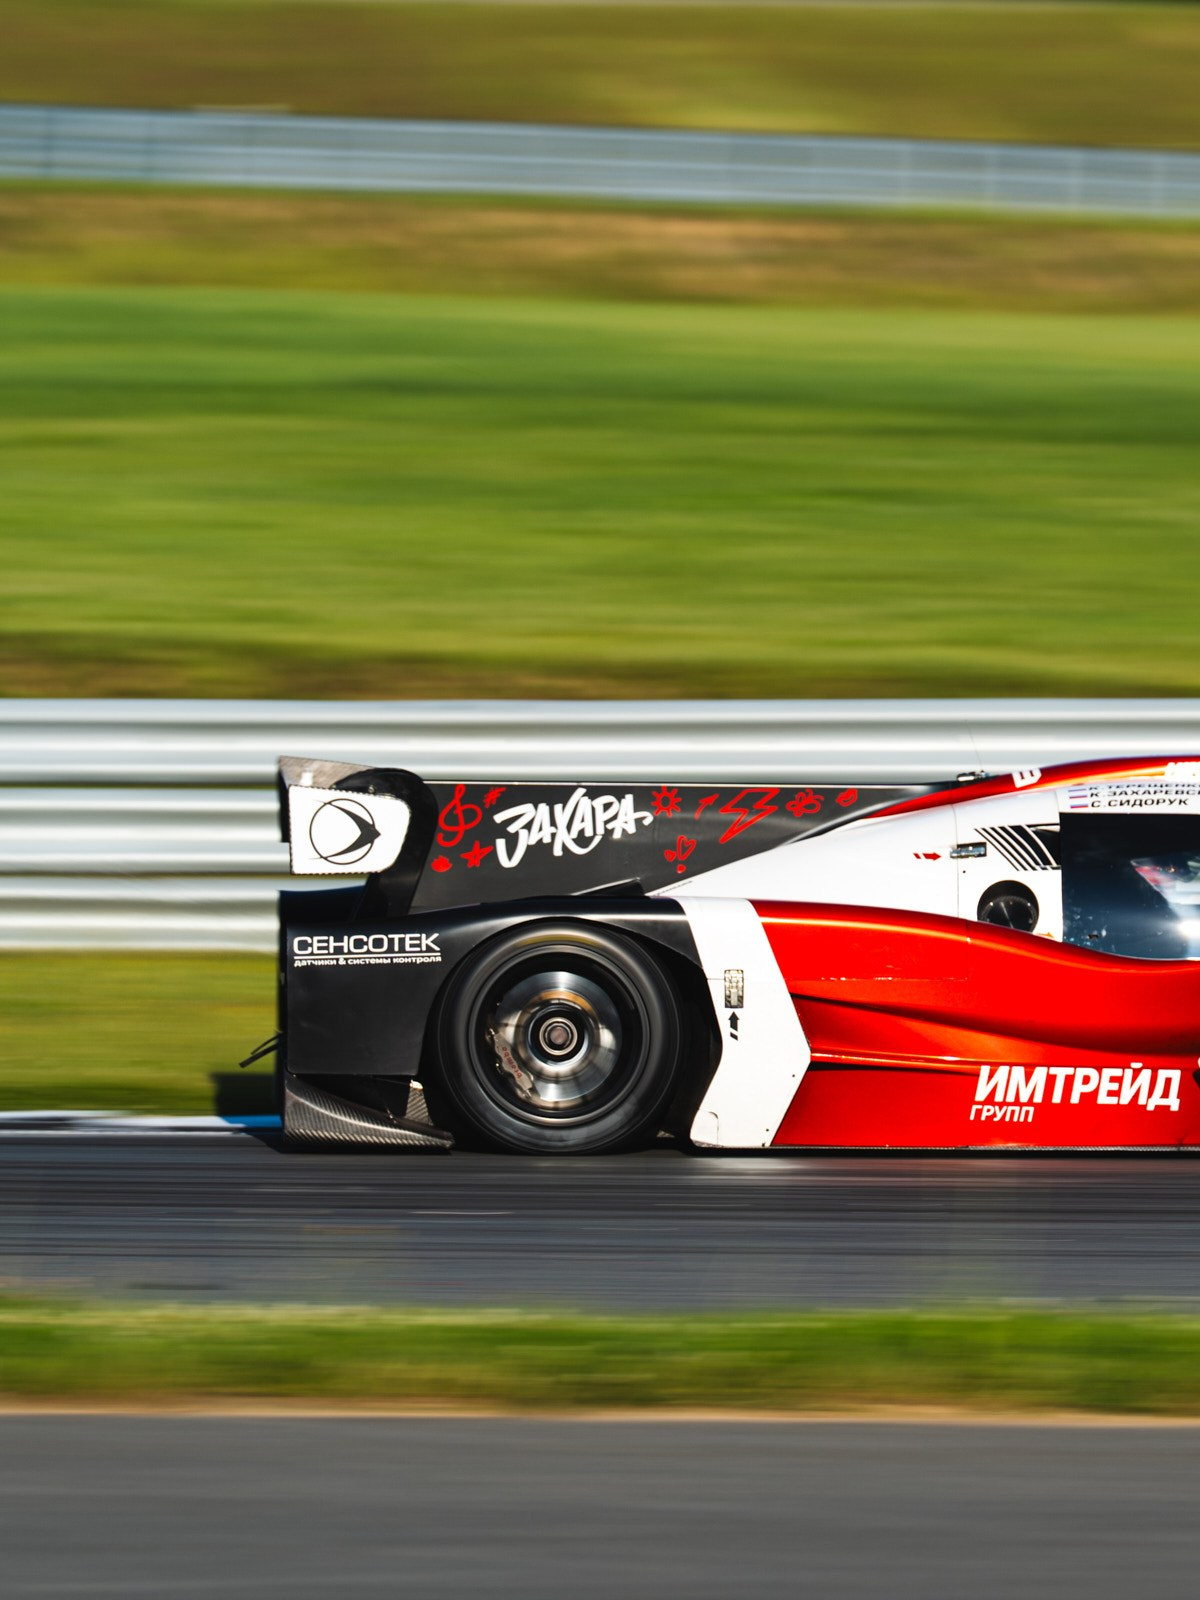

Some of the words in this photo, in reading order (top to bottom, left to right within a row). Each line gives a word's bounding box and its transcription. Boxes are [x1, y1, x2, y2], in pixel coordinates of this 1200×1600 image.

[293, 933, 441, 955] СЕНСОТЕК
[294, 958, 337, 968] датчики
[348, 956, 392, 966] системы
[393, 955, 442, 965] контроля
[974, 1062, 1182, 1112] ИМТРЕЙД
[969, 1105, 1035, 1122] ГРУПП
